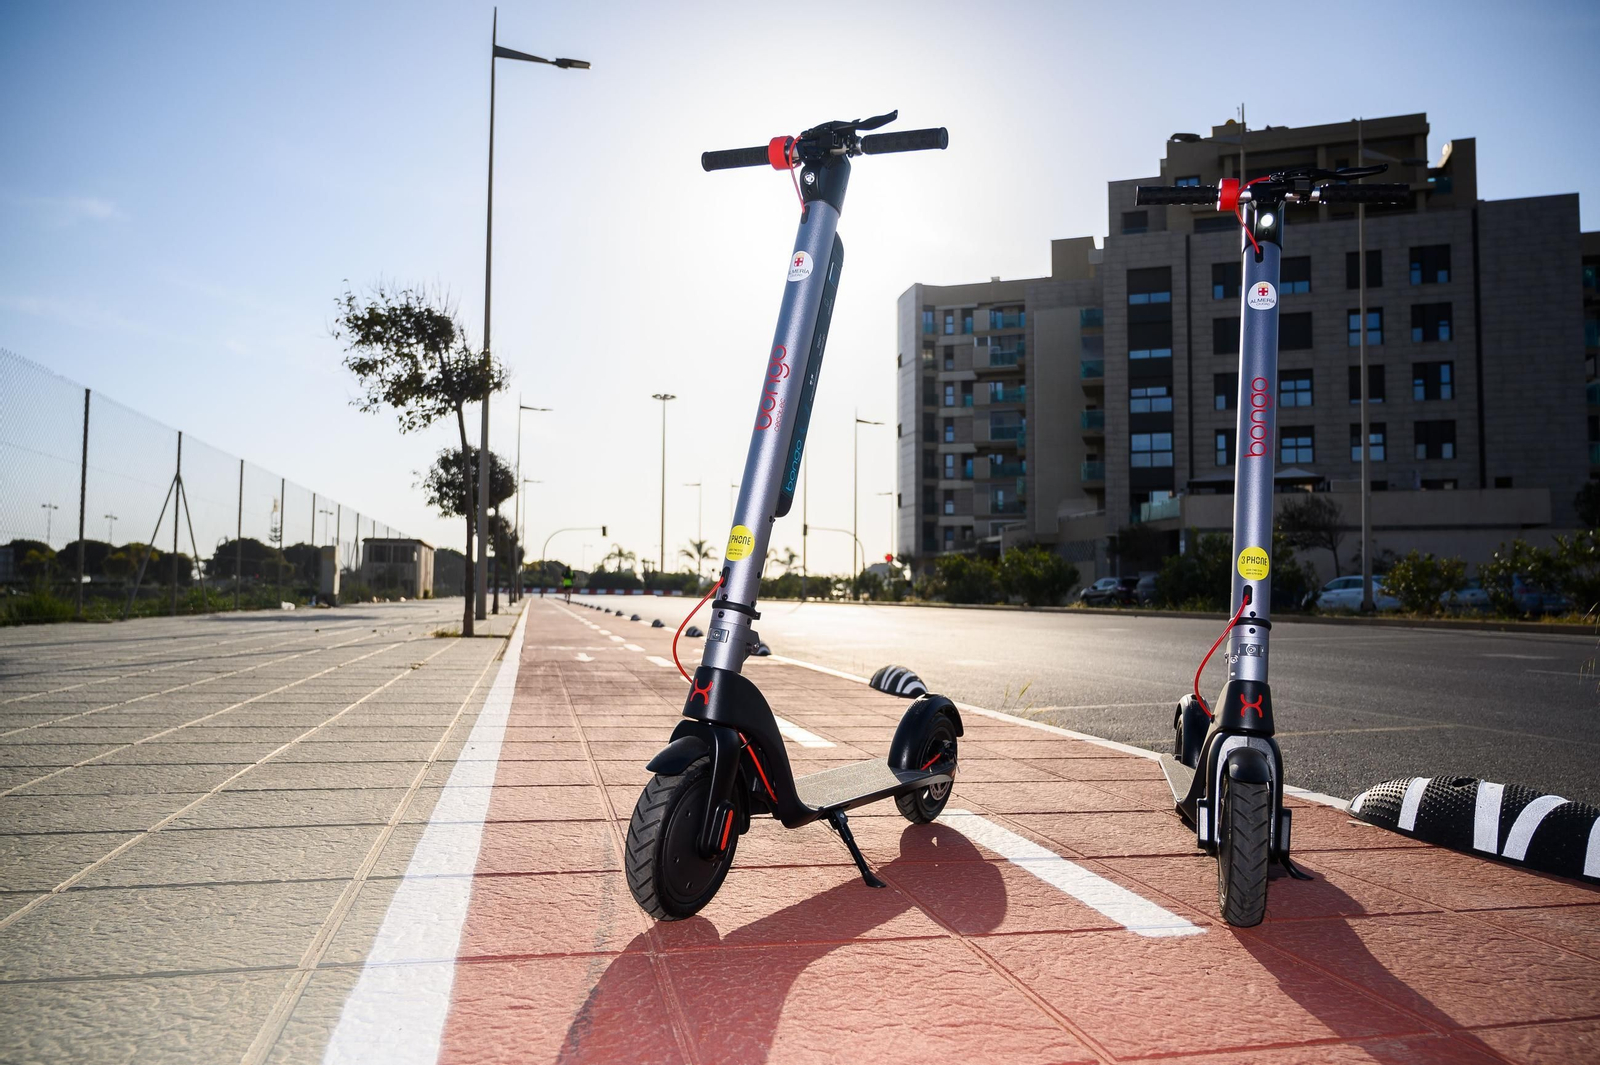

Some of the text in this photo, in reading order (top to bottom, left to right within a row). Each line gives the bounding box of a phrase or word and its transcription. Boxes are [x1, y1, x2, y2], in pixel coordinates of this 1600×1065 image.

[755, 345, 790, 430] bongo
[1243, 377, 1273, 458] bongo
[785, 440, 802, 492] bongo
[1241, 555, 1246, 564] 3
